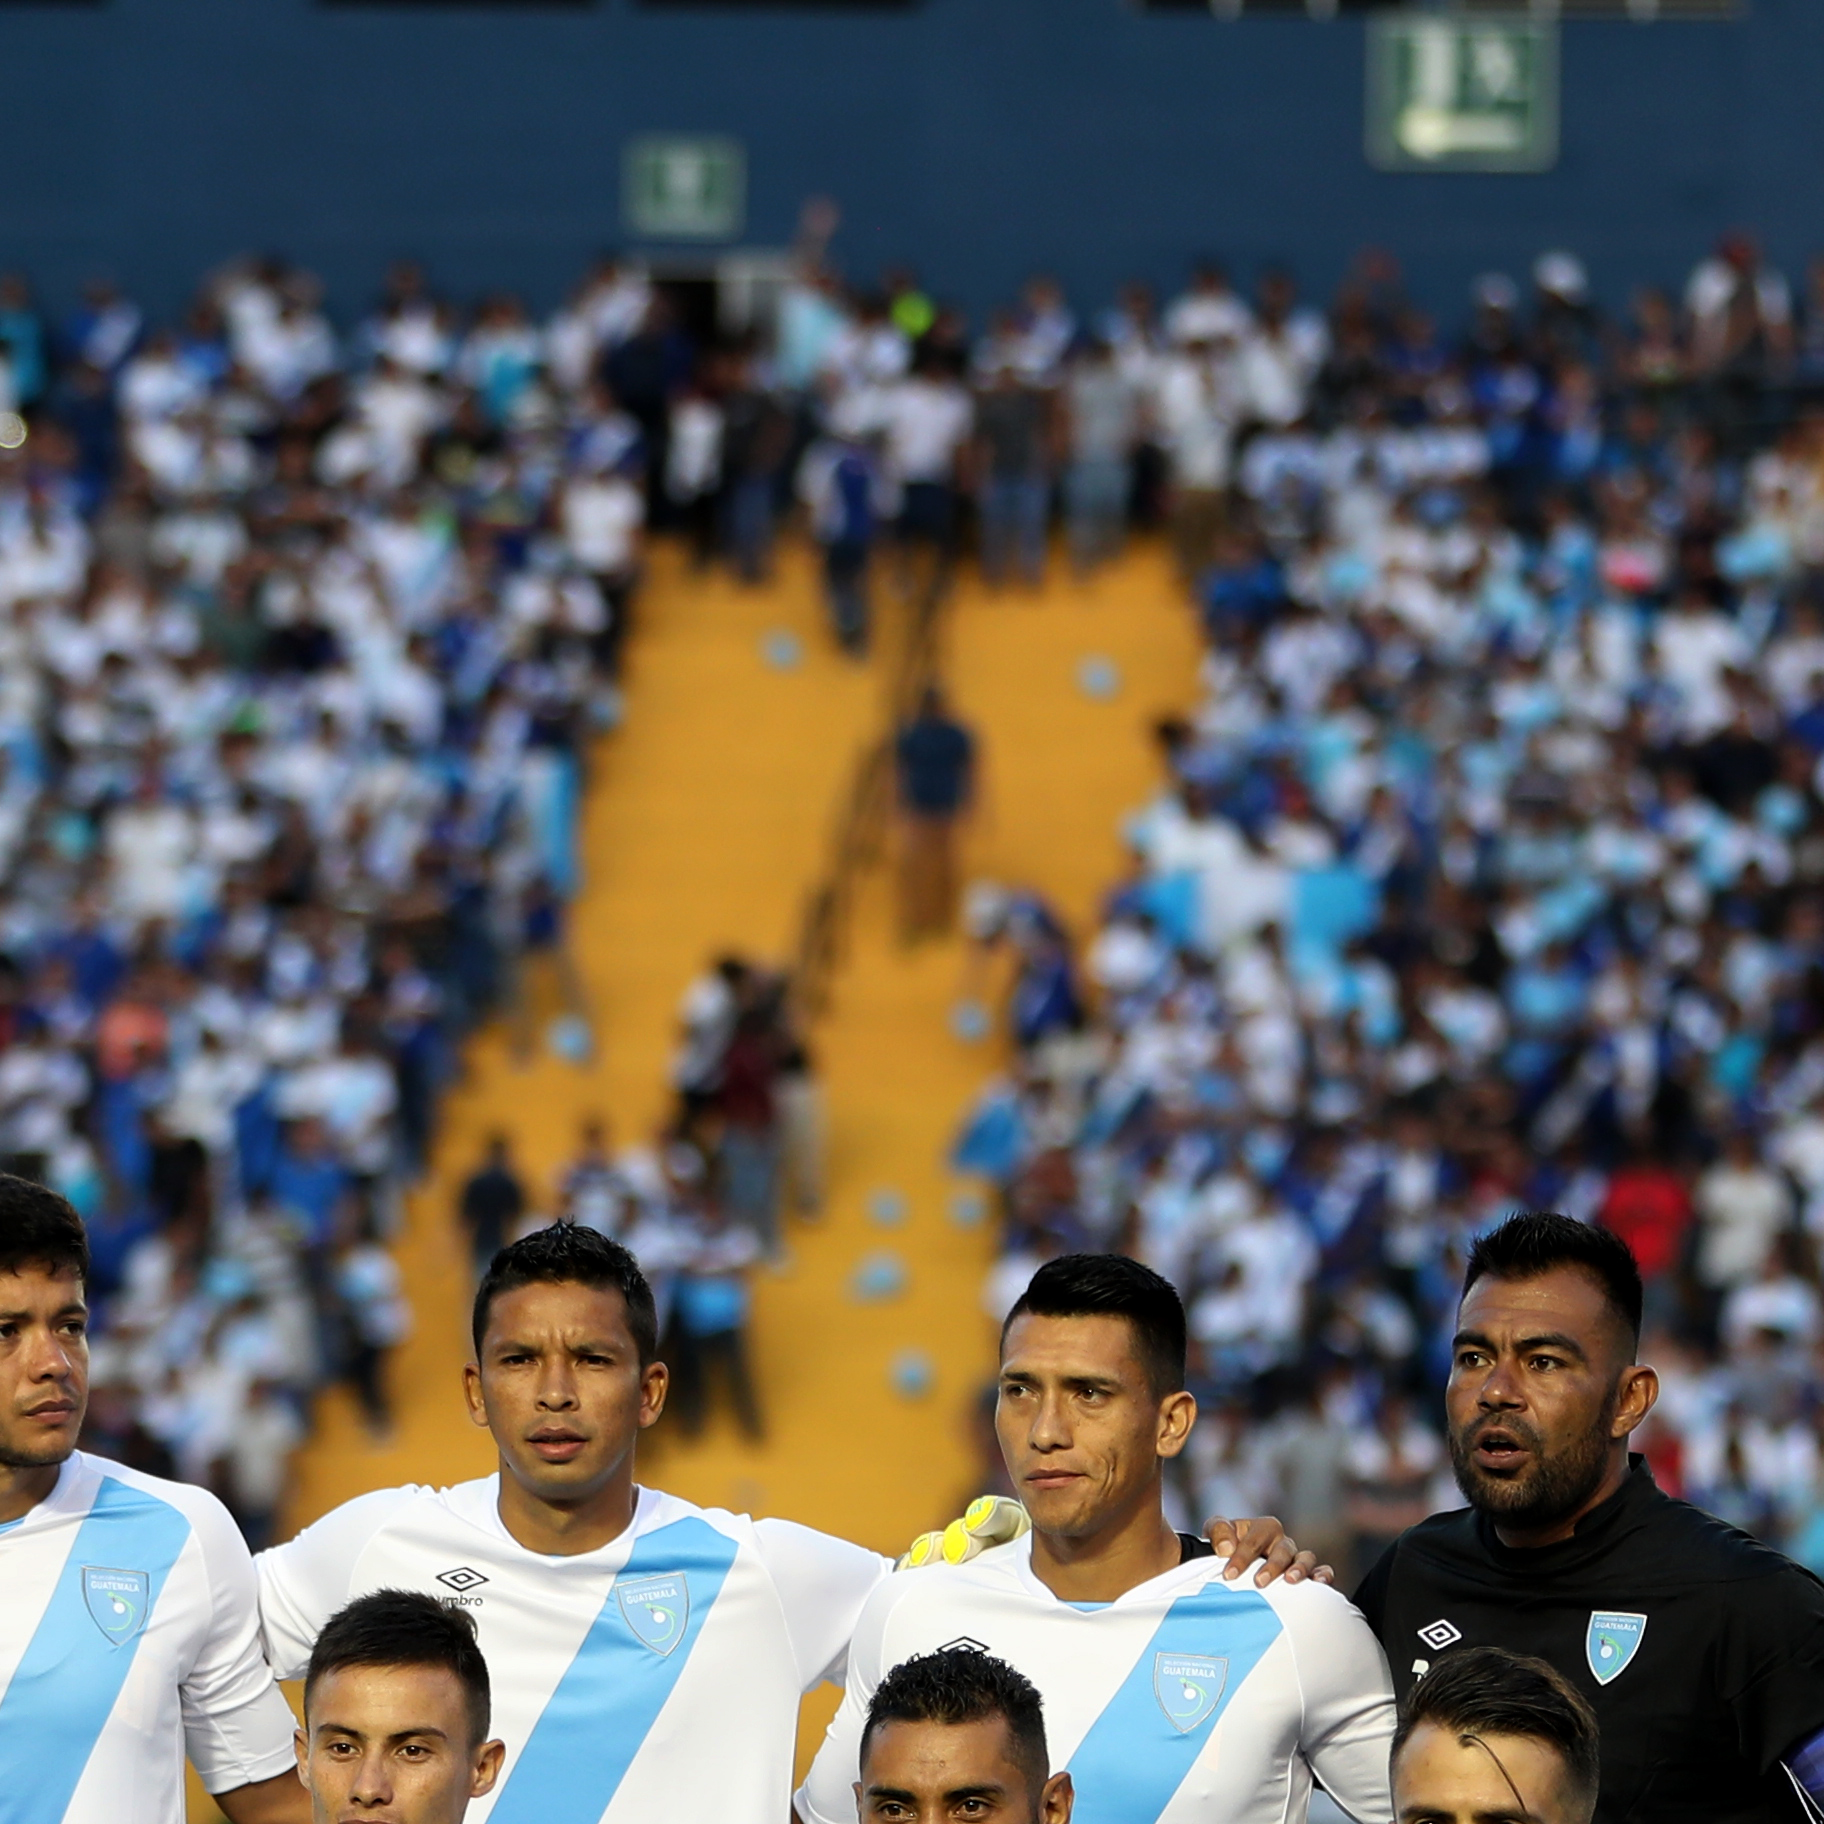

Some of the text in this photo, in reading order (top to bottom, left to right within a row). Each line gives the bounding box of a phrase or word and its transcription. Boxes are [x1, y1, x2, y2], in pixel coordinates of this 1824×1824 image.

[90, 1580, 140, 1593] GUATEMALA
[626, 1588, 678, 1605] GUATEMALA
[1594, 1621, 1638, 1632] GUATEMALA
[1162, 1665, 1216, 1679] GUATEMALA
